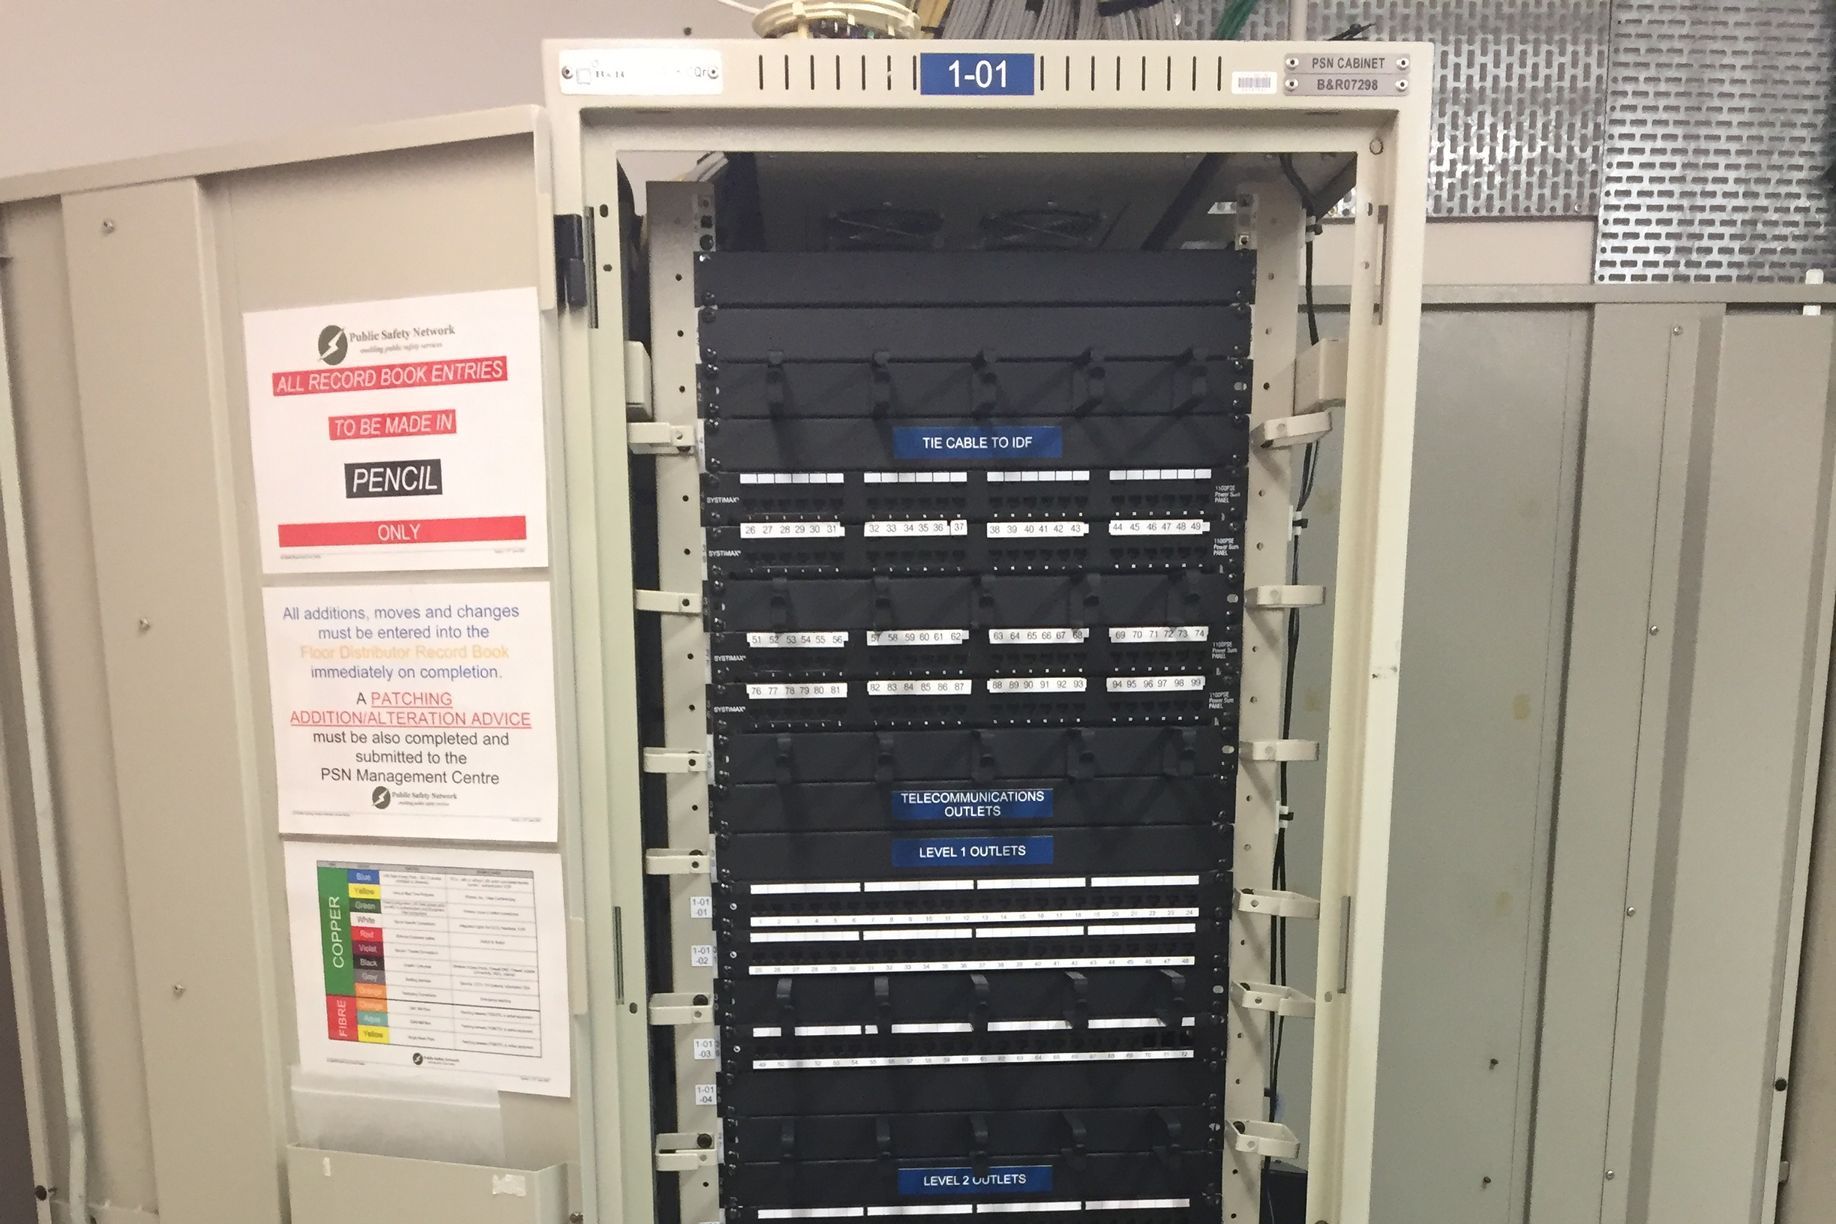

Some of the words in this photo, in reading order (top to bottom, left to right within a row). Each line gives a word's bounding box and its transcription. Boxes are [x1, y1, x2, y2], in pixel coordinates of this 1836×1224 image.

[1312, 57, 1334, 69] PSN
[1337, 57, 1386, 69] CABINET
[948, 60, 1006, 88] 1-01
[1317, 79, 1378, 91] B&R07298
[350, 330, 379, 342] Public
[381, 328, 410, 341] Safety
[413, 324, 456, 338] Network
[276, 375, 304, 393] ALL
[308, 369, 377, 390] RECORD
[380, 366, 427, 386] BOOK
[431, 360, 503, 382] ENTRIES
[334, 418, 356, 436] TO
[360, 417, 381, 435] BE
[385, 415, 431, 433] MADE
[436, 413, 452, 431] IN
[922, 438, 942, 449] TIE
[946, 436, 988, 449] CABLE
[992, 437, 1008, 448] TO
[1012, 436, 1032, 448] IDF
[353, 465, 438, 493] PENCIL
[378, 524, 421, 541] ONLY
[744, 525, 756, 535] 26
[762, 525, 772, 535] 27
[780, 525, 790, 534] 28
[794, 525, 806, 534] 29
[810, 524, 820, 534] 30
[826, 524, 836, 534] 31
[869, 524, 880, 533] 32
[886, 524, 896, 533] 33
[904, 523, 914, 532] 34
[918, 523, 929, 532] 35
[933, 523, 944, 531] 36
[954, 522, 964, 531] 37
[990, 526, 1000, 534] 38
[1006, 525, 1017, 534] 39
[1024, 525, 1034, 534] 40
[1038, 525, 1048, 533] 41
[1053, 525, 1064, 533] 42
[1070, 524, 1081, 533] 43
[1112, 523, 1123, 532] 44
[1129, 523, 1140, 531] 45
[1146, 523, 1157, 531] 46
[1161, 522, 1171, 531] 47
[1176, 522, 1186, 531] 48
[1190, 522, 1201, 530] 49
[283, 606, 300, 621] All
[304, 606, 370, 621] additions,
[374, 608, 421, 620] moves
[425, 605, 452, 619] and
[457, 604, 520, 621] changes
[318, 627, 351, 640] must
[356, 626, 373, 639] be
[378, 626, 431, 639] entered
[436, 625, 462, 639] into
[466, 625, 489, 638] the
[300, 645, 335, 659] Floor
[340, 645, 410, 659] Distributor
[415, 644, 468, 659] Record
[472, 644, 510, 658] Book
[311, 665, 393, 681] immediately
[398, 668, 416, 679] on
[420, 665, 502, 682] completion.
[870, 683, 880, 692] 82
[887, 683, 898, 692] 83
[904, 683, 914, 692] 84
[920, 682, 931, 692] 85
[937, 682, 948, 691] 86
[954, 682, 964, 691] 87
[992, 681, 1003, 690] 88
[1008, 680, 1020, 689] 89
[1023, 680, 1034, 689] 90
[1040, 680, 1049, 689] 91
[1056, 680, 1067, 689] 92
[1073, 679, 1084, 688] 93
[1112, 680, 1123, 689] 94
[1126, 679, 1137, 688] 95
[1143, 679, 1154, 688] 96
[1158, 679, 1167, 688] 97
[1174, 678, 1185, 687] 98
[1190, 678, 1201, 687] 99
[751, 686, 762, 696] 76
[768, 686, 778, 695] 77
[785, 686, 795, 695] 78
[800, 686, 810, 695] 79
[814, 685, 824, 695] 80
[830, 685, 840, 694] 81
[356, 692, 367, 705] A
[371, 692, 453, 706] PATCHING
[290, 711, 466, 726] ADDITION/ALTERATION
[471, 712, 531, 726] ADVICE
[313, 731, 346, 744] must
[350, 730, 368, 744] be
[372, 731, 400, 744] also
[404, 732, 478, 748] completed
[482, 733, 509, 746] and
[356, 751, 422, 764] submitted
[427, 752, 441, 764] to
[445, 752, 467, 765] the
[320, 768, 352, 782] PSN
[356, 768, 447, 786] Management
[452, 771, 500, 785] Centre
[900, 791, 1044, 804] TELECOMMUNICATIONS
[944, 806, 1000, 817] OUTLETS
[920, 847, 957, 858] LEVEL
[960, 847, 966, 857] 1
[970, 845, 1026, 857] OUTLETS
[355, 901, 376, 910] Green
[356, 916, 376, 924] White
[328, 896, 345, 969] COPPER
[360, 930, 374, 939] Red
[358, 944, 378, 953] Violet
[360, 958, 378, 967] Black
[338, 1000, 348, 1038] FIBRE
[924, 1176, 960, 1187] LEVEL
[962, 1176, 969, 1186] 2
